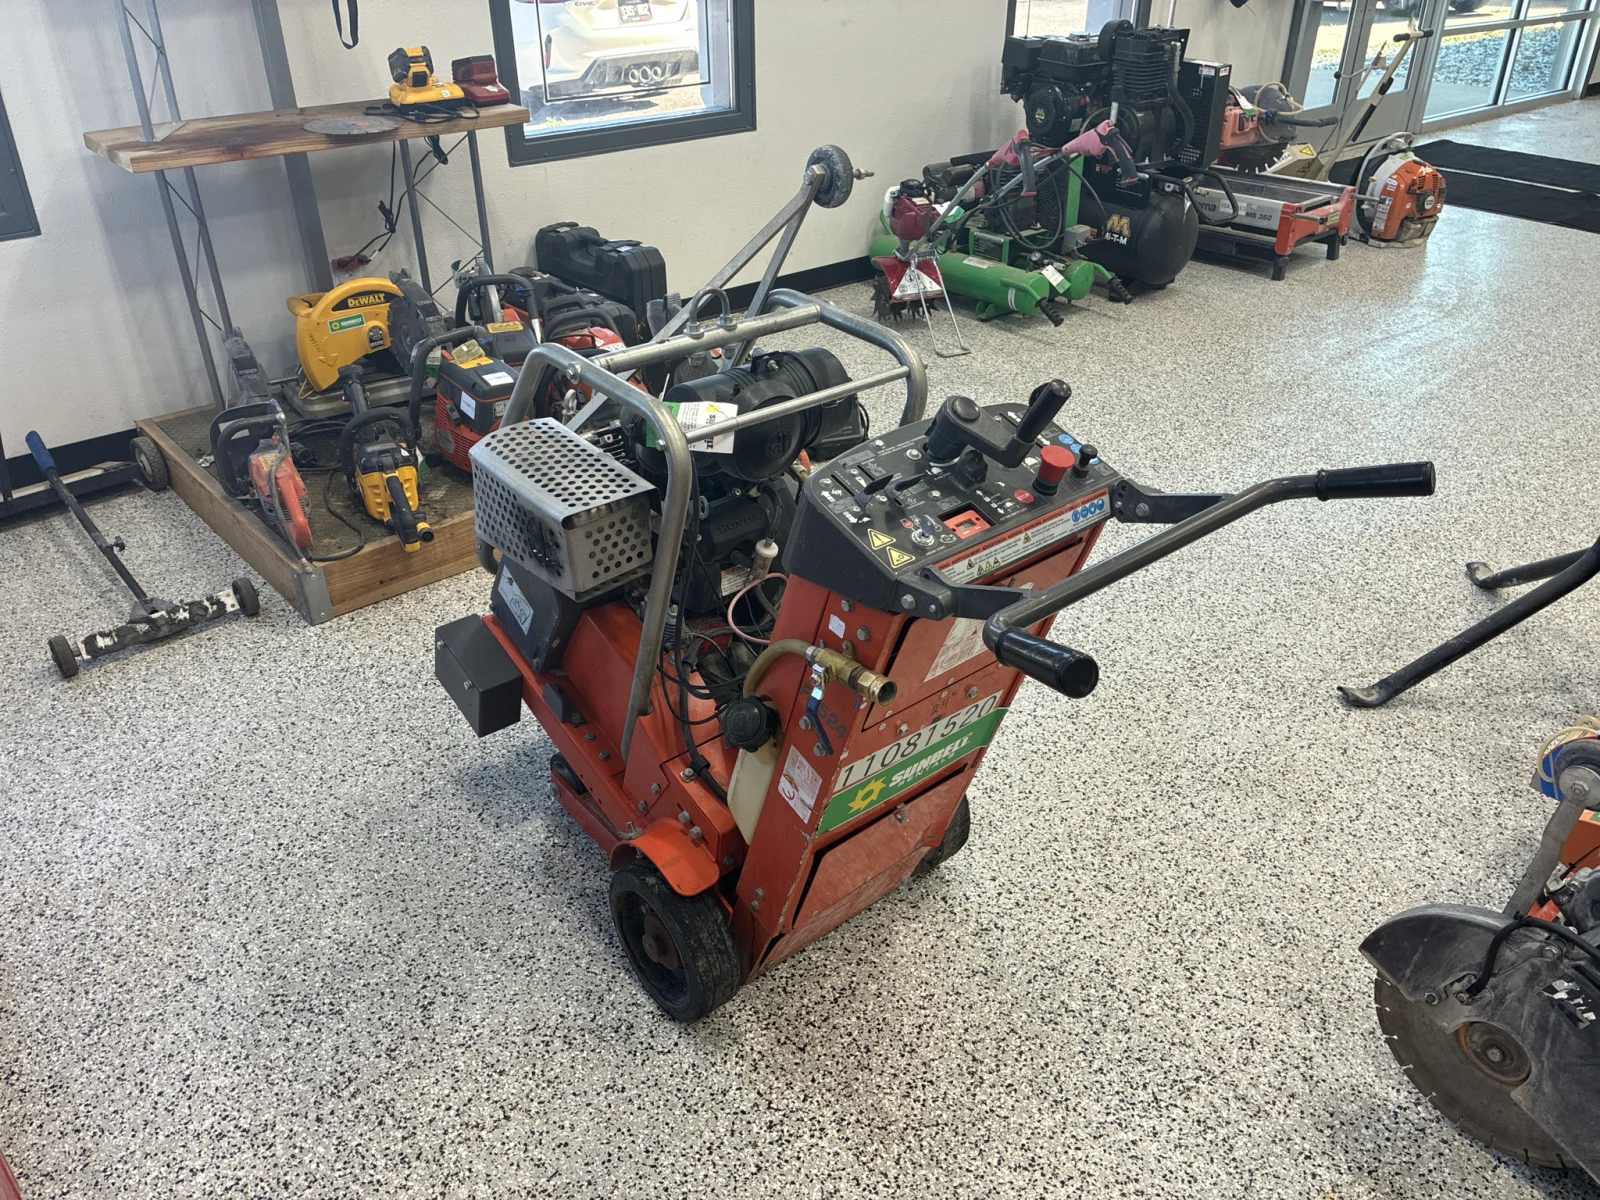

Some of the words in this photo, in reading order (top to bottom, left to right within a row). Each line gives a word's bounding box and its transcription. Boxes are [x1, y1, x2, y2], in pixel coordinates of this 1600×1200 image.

[1258, 214, 1273, 222] 360
[348, 293, 385, 307] DEWALT
[1017, 492, 1030, 502] STOP
[843, 695, 997, 788] 11081520
[889, 732, 974, 788] SUNBELT
[898, 752, 957, 788] RENTALS
